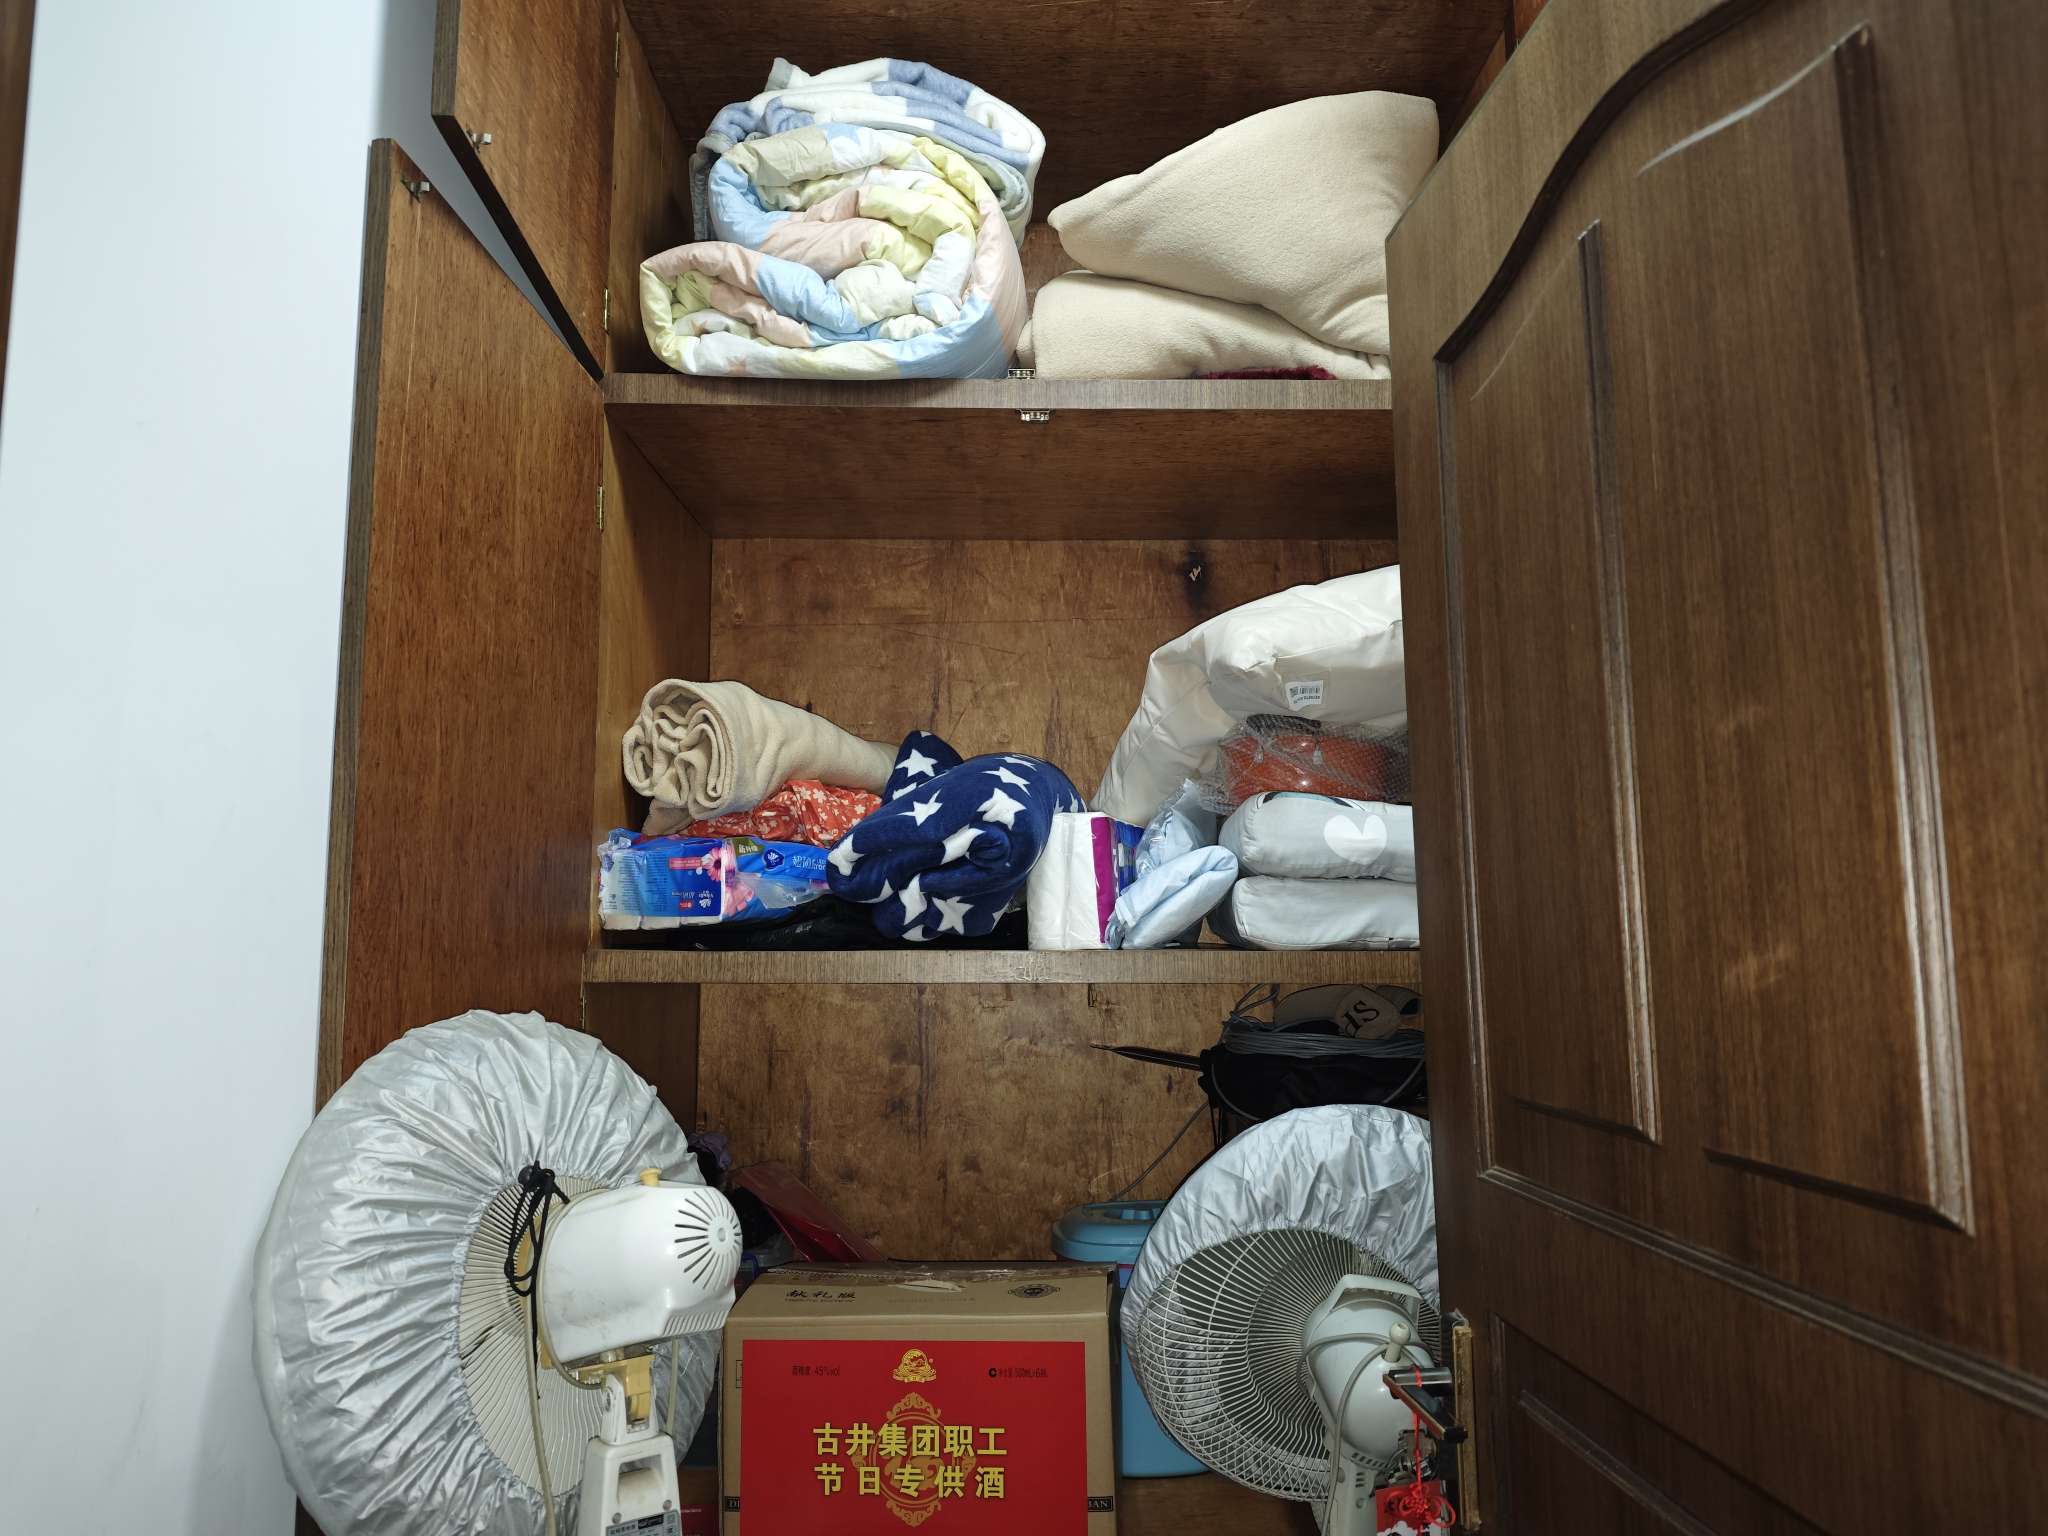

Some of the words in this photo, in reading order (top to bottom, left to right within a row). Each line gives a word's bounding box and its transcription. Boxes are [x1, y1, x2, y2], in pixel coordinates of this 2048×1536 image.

[813, 1422, 1007, 1457] 古井集团职工
[814, 1463, 1006, 1498] 节日专供酒
